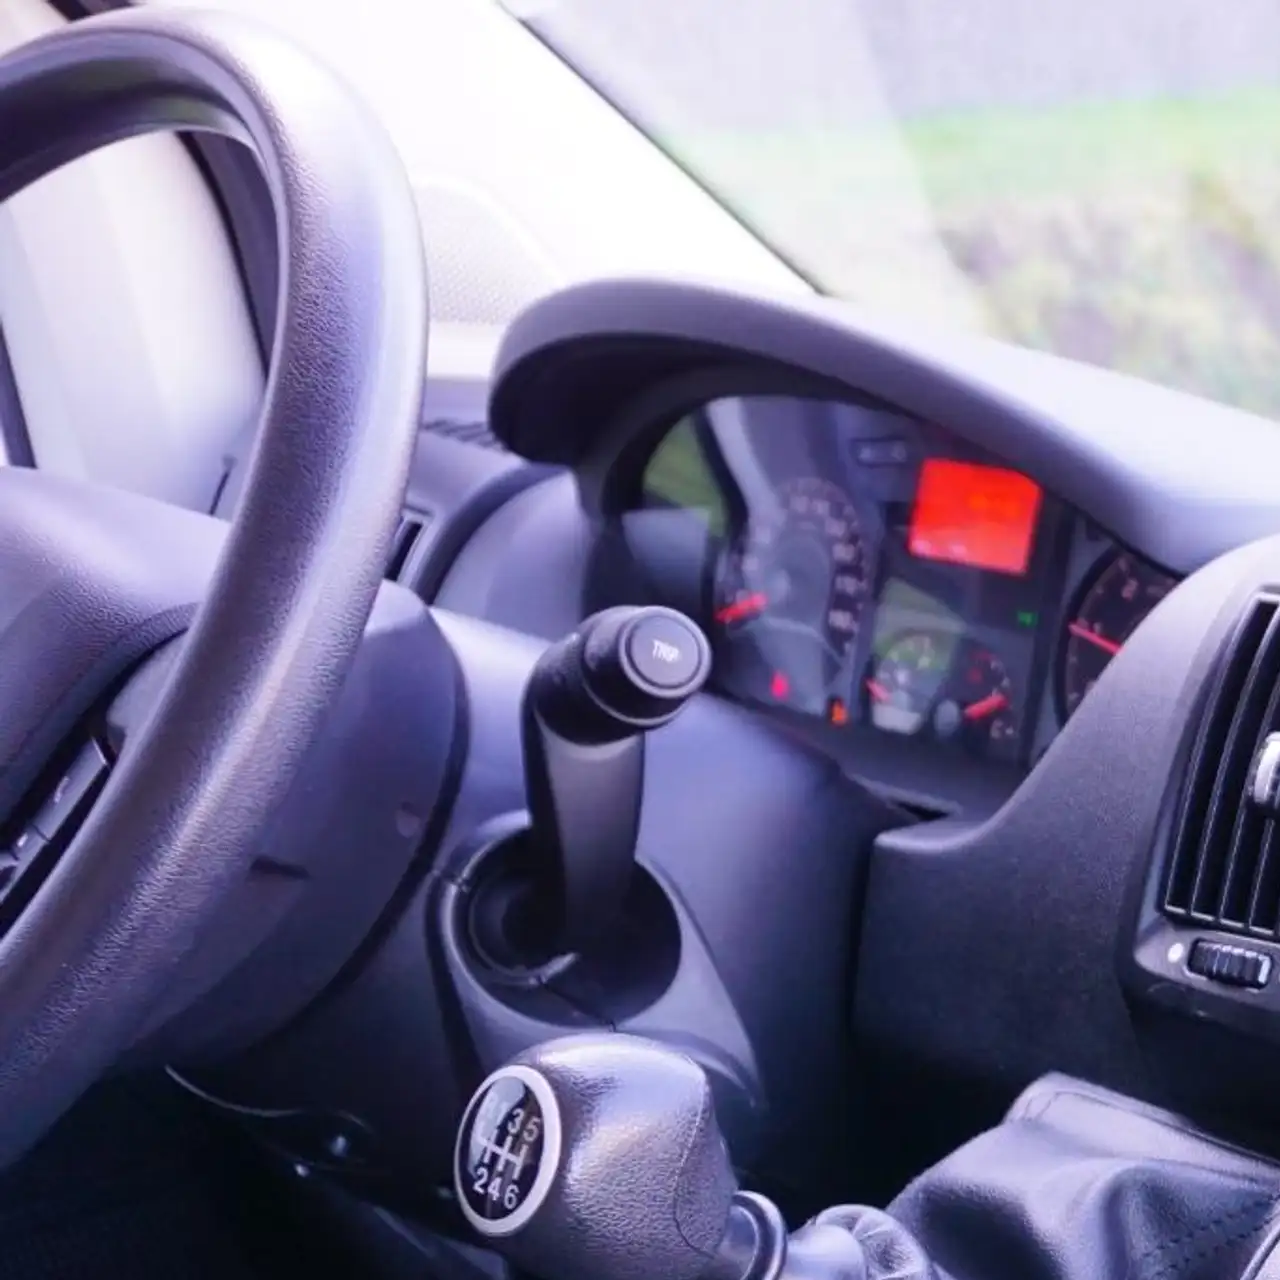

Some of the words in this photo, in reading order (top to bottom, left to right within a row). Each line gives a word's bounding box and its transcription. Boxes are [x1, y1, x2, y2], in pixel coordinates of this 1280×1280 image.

[507, 1108, 524, 1133] 3
[523, 1117, 540, 1142] 5
[473, 1167, 489, 1195] 2
[487, 1176, 503, 1201] 4
[504, 1184, 520, 1210] 6
